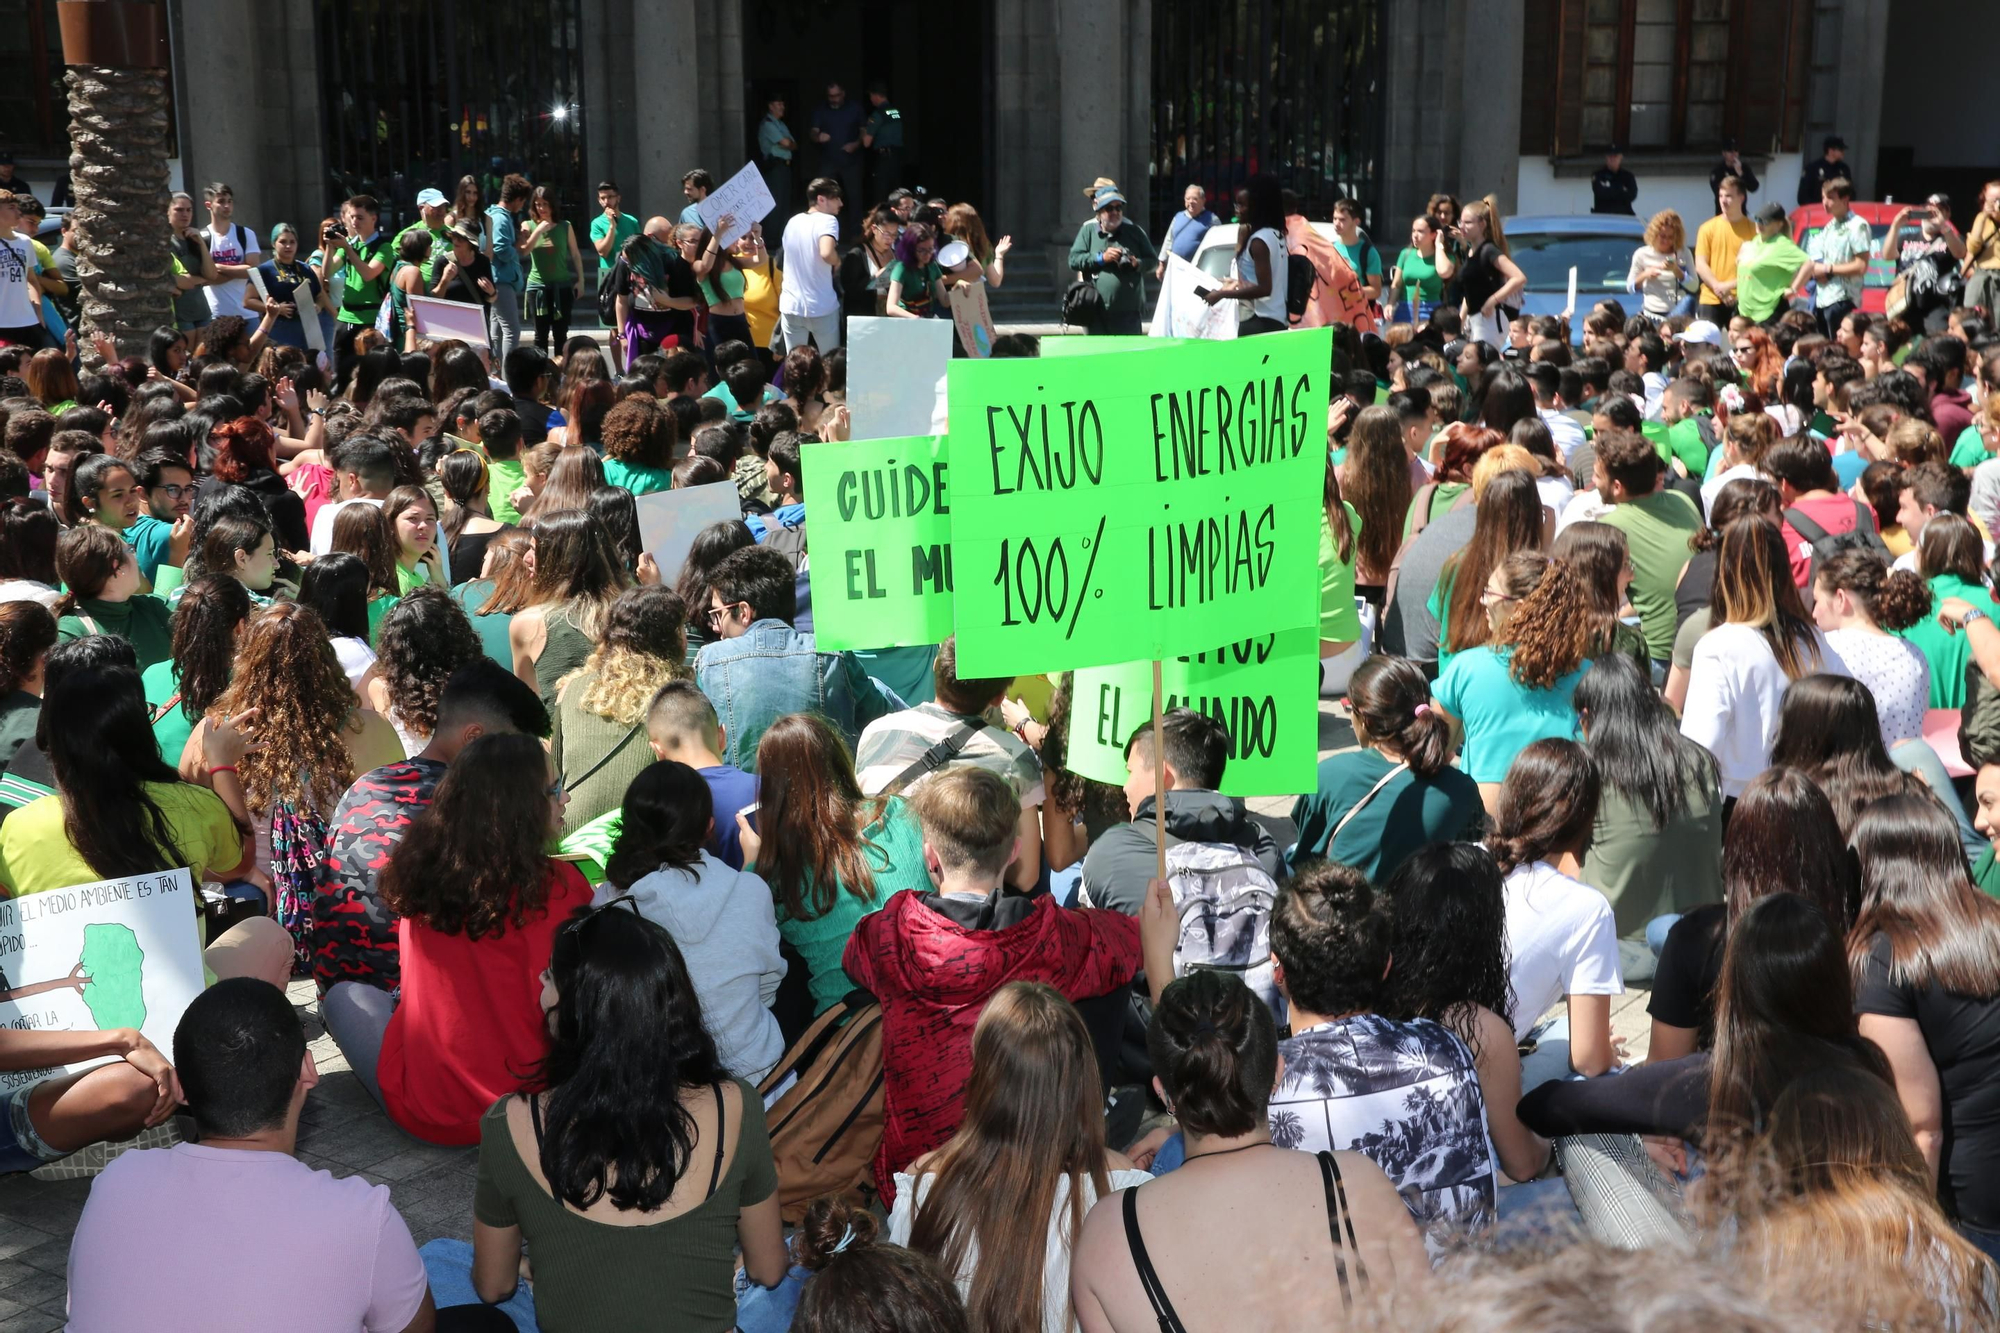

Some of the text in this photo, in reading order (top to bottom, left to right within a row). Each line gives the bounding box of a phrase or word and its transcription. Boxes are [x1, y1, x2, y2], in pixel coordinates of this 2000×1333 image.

[701, 183, 739, 218] COMER
[10, 267, 22, 282] 64
[986, 355, 1310, 495] EXIJO ENERGÍAS
[845, 549, 887, 600] EL
[993, 496, 1275, 640] 100% LIMPIAS
[1097, 684, 1277, 760] EL NDO
[20, 901, 37, 922] EL
[39, 887, 77, 917] MEDIO
[80, 881, 134, 908] AMBIENTE
[137, 881, 152, 898] ES
[155, 875, 179, 895] TAN
[45, 1010, 59, 1026] LA
